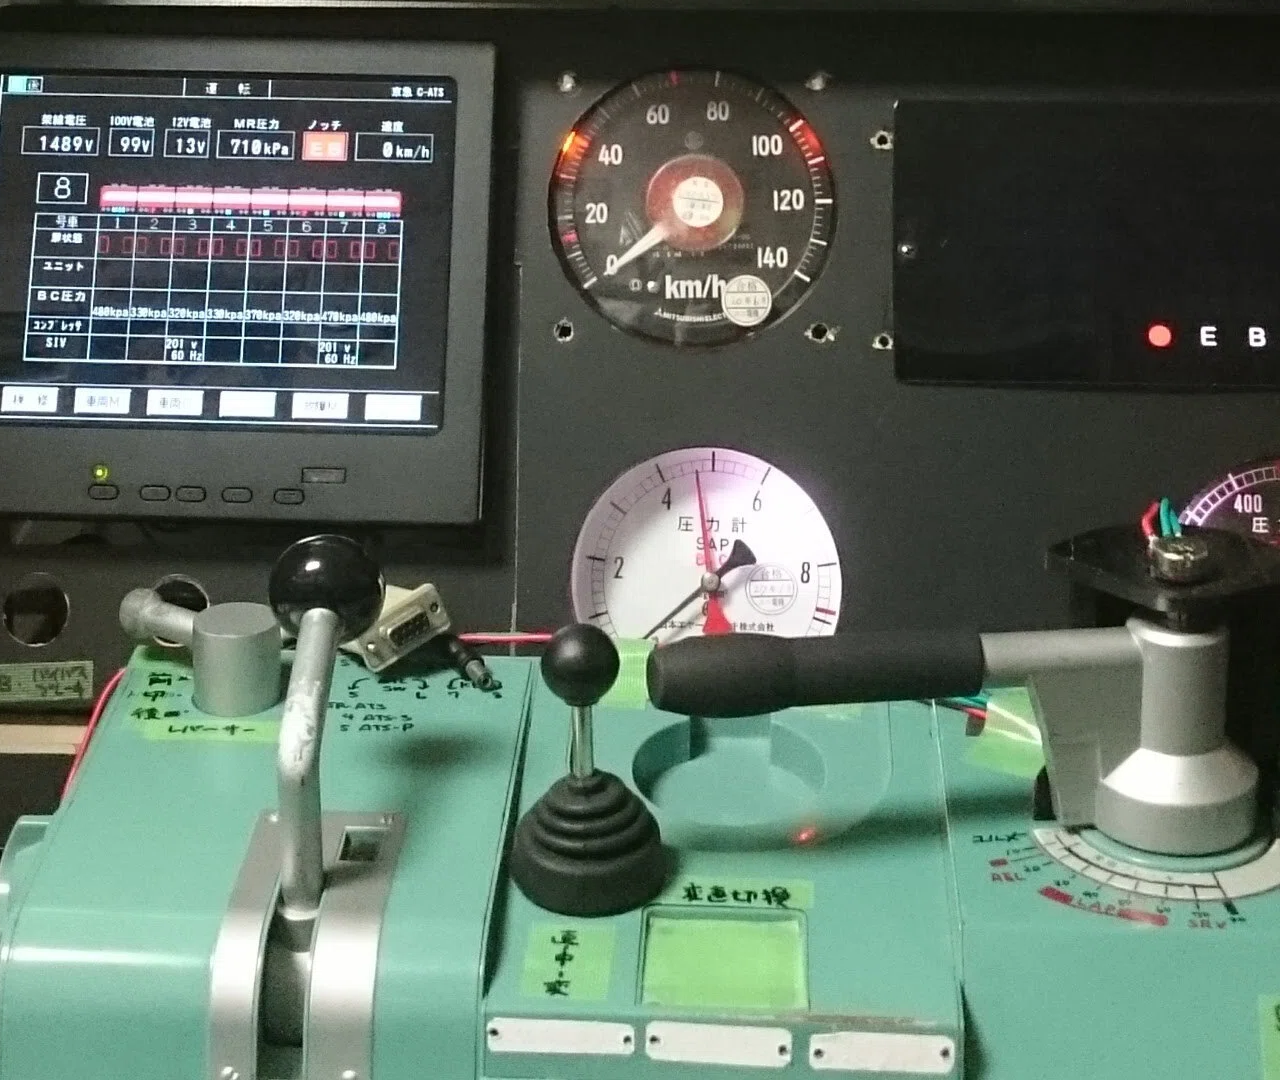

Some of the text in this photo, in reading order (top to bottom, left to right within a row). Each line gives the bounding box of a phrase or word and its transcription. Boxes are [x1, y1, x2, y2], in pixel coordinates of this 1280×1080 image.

[308, 120, 342, 131] ノッチ
[599, 101, 783, 165] 40 60 80 100
[54, 176, 71, 199] 8
[585, 189, 804, 224] 20 120
[114, 218, 120, 229] 1
[150, 218, 159, 230] 2
[188, 219, 197, 230] 3
[225, 220, 236, 231] 4
[263, 221, 273, 232] 5
[302, 221, 312, 233] 6
[340, 222, 350, 233] 7
[377, 223, 387, 234] 8
[43, 261, 84, 271] ユニット
[757, 247, 788, 268] 140
[665, 274, 727, 300] km/h
[1233, 494, 1262, 513] 400
[677, 516, 747, 533] 圧力計
[613, 488, 810, 584] 2 4 6 8
